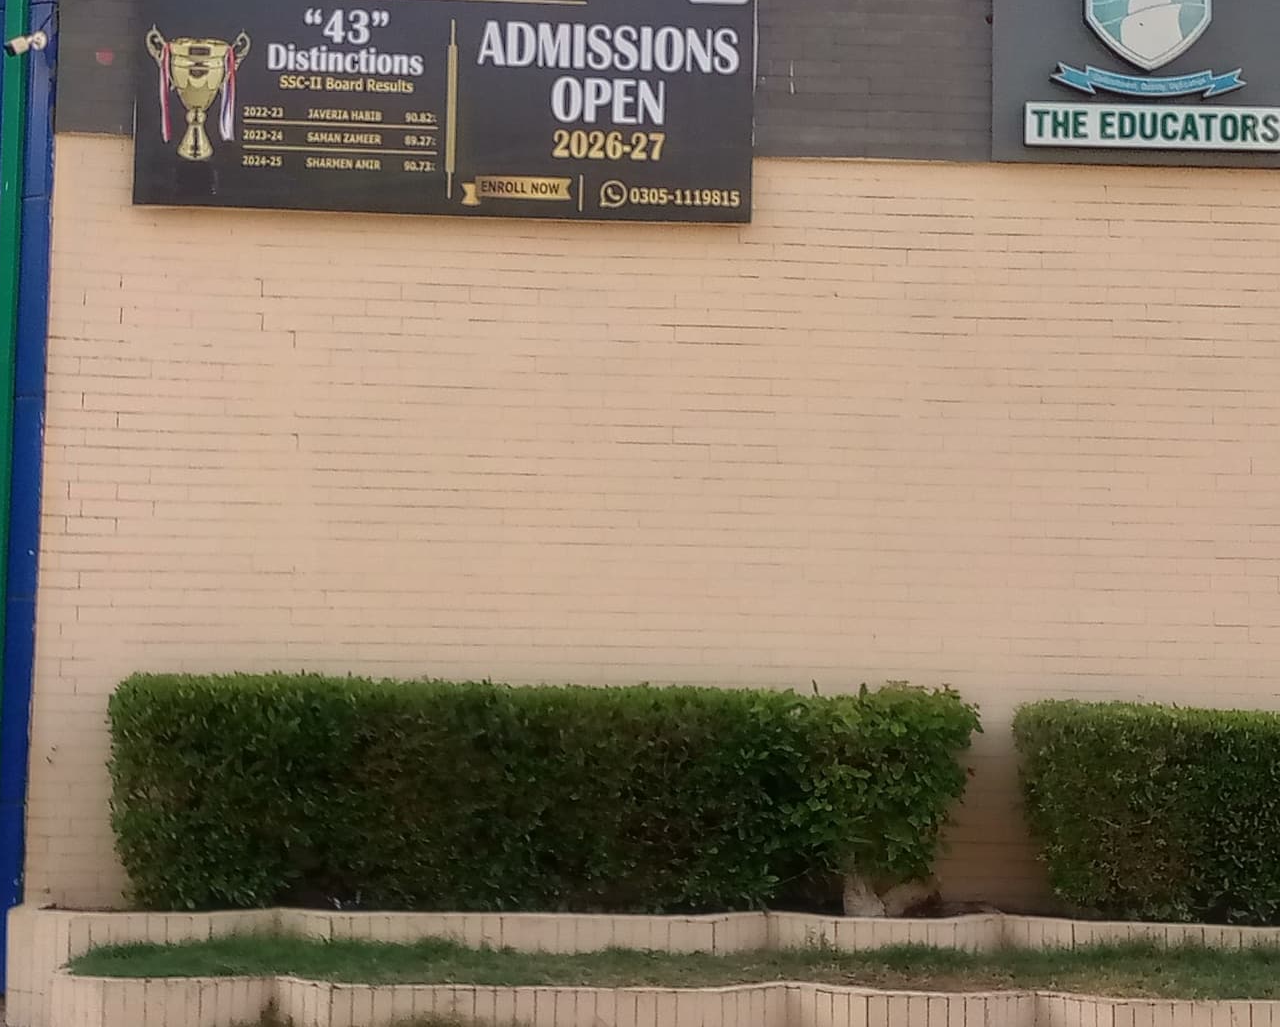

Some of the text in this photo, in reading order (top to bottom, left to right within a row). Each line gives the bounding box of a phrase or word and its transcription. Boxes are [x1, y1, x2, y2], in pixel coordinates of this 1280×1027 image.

[477, 20, 740, 75] ADMISSIONS
[267, 43, 425, 76] Distinctions
[279, 75, 414, 93] SSC-II Board Results
[550, 76, 665, 125] OPEN
[243, 105, 284, 118] 2022-23
[242, 129, 283, 141] 2023-24
[1031, 109, 1279, 143] THE EDUCATORS
[552, 130, 665, 160] 2026-27
[242, 154, 282, 167] 2024-25
[480, 180, 560, 195] ENROLL NOW
[630, 189, 740, 206] 0305-1119815
